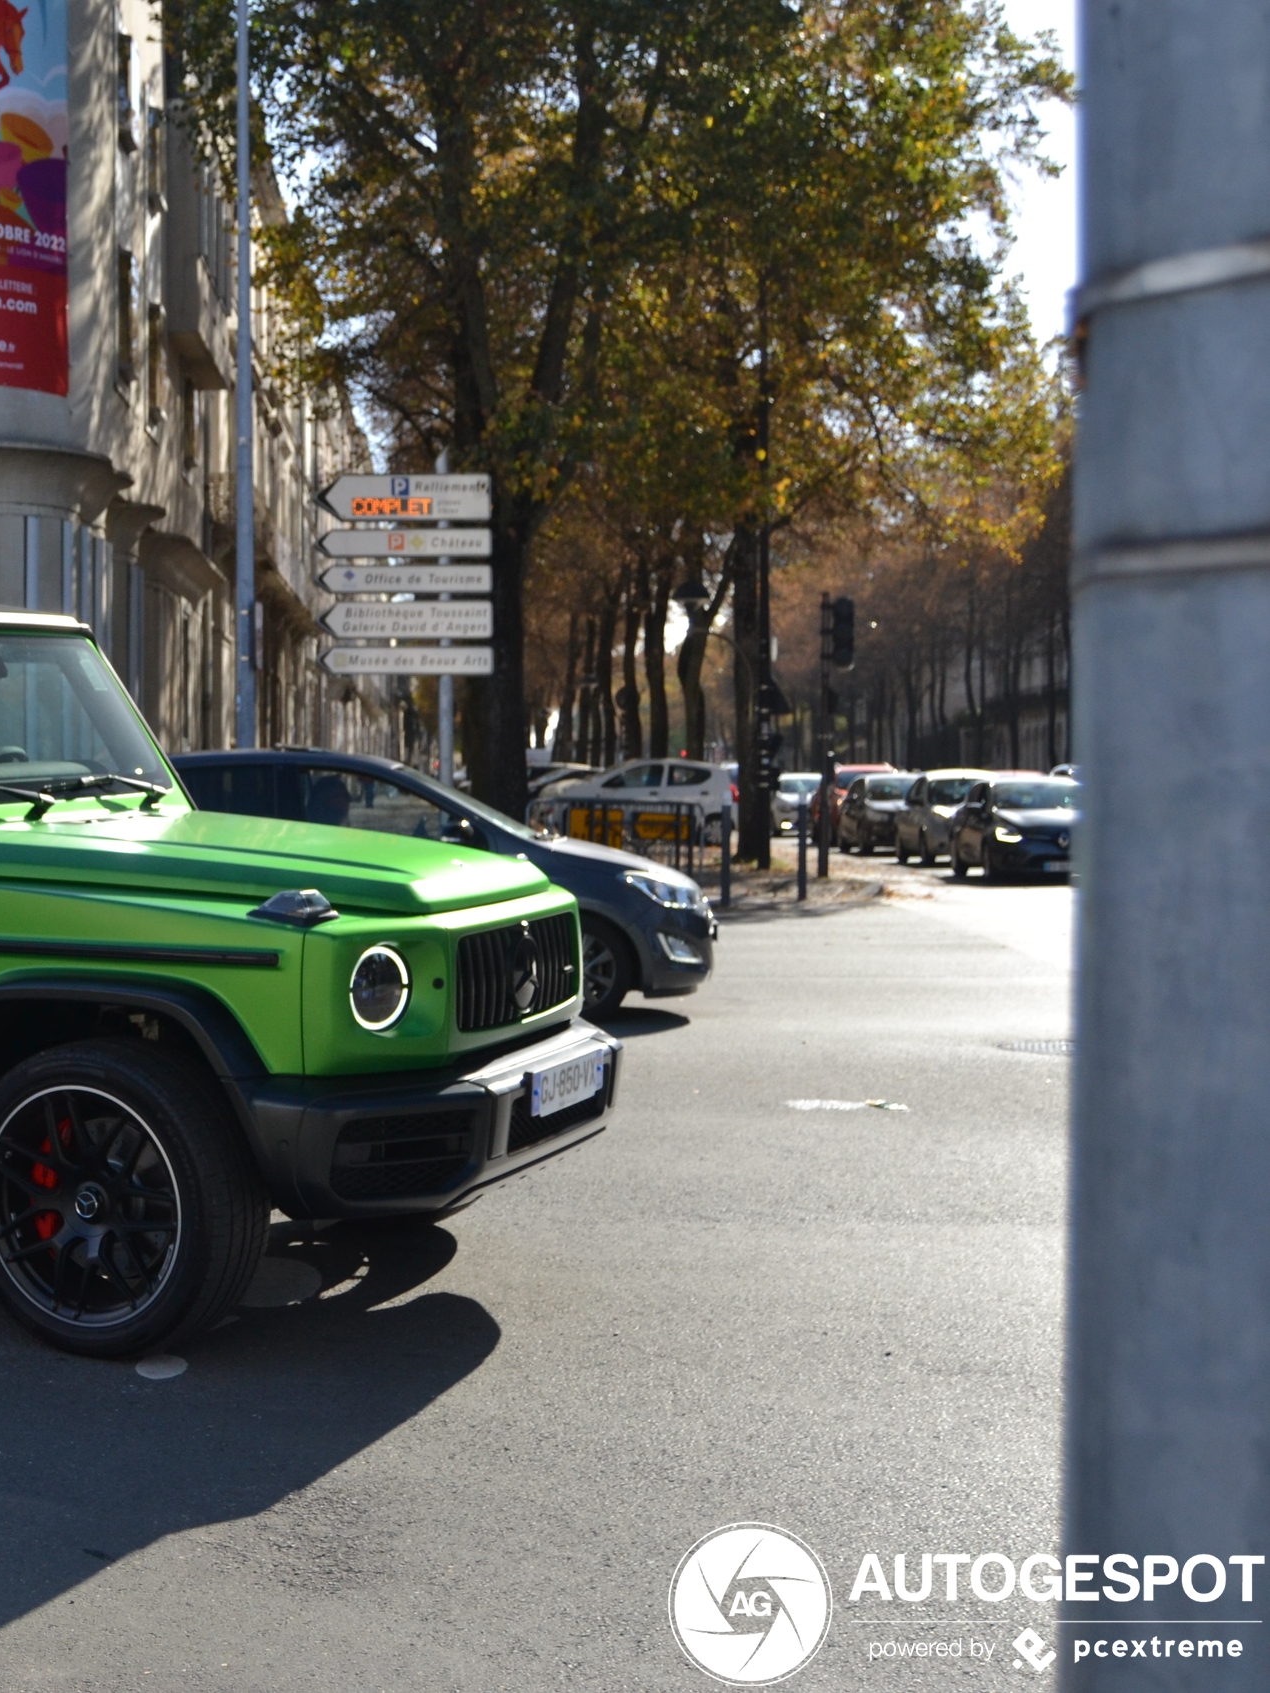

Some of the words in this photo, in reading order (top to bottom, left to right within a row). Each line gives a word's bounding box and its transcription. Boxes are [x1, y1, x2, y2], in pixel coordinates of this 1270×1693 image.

[34, 230, 66, 253] 2022
[351, 497, 433, 517] COMPLET
[431, 536, 482, 549] Château
[364, 573, 402, 585] Office
[407, 573, 422, 585] de
[428, 573, 483, 585] Tourisme
[345, 607, 424, 620] Bibliothèque
[430, 607, 488, 618] Toussaint
[342, 621, 386, 633] Galerie
[391, 621, 427, 632] David
[348, 654, 389, 666] Musée
[394, 654, 415, 666] des
[420, 655, 457, 666] Beaux
[463, 655, 489, 666] Arts
